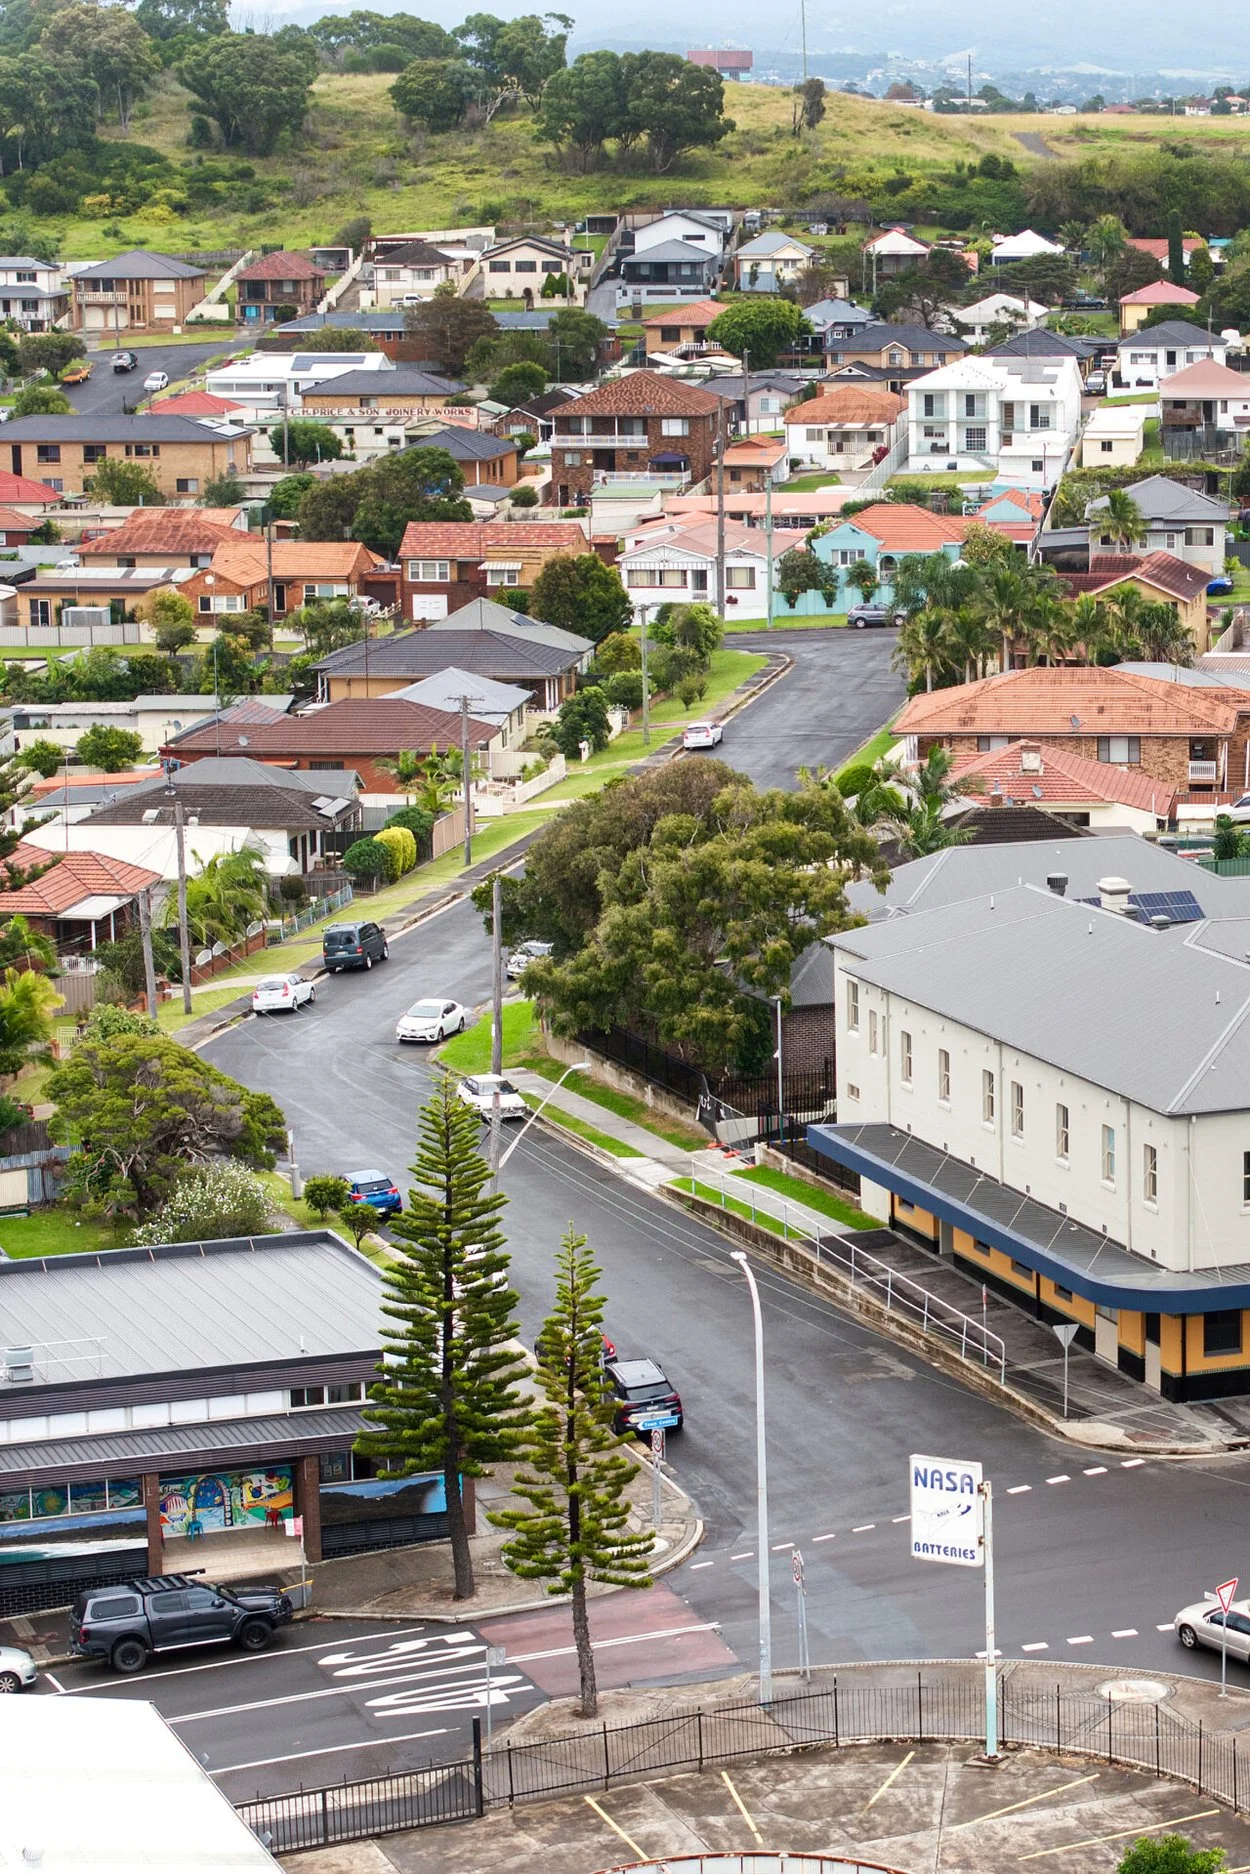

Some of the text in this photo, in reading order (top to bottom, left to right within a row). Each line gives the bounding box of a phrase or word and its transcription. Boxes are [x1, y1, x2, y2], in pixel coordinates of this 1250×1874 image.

[914, 1466, 974, 1494] NASA
[914, 1541, 976, 1560] BATTERIES
[317, 1631, 488, 1676] 50
